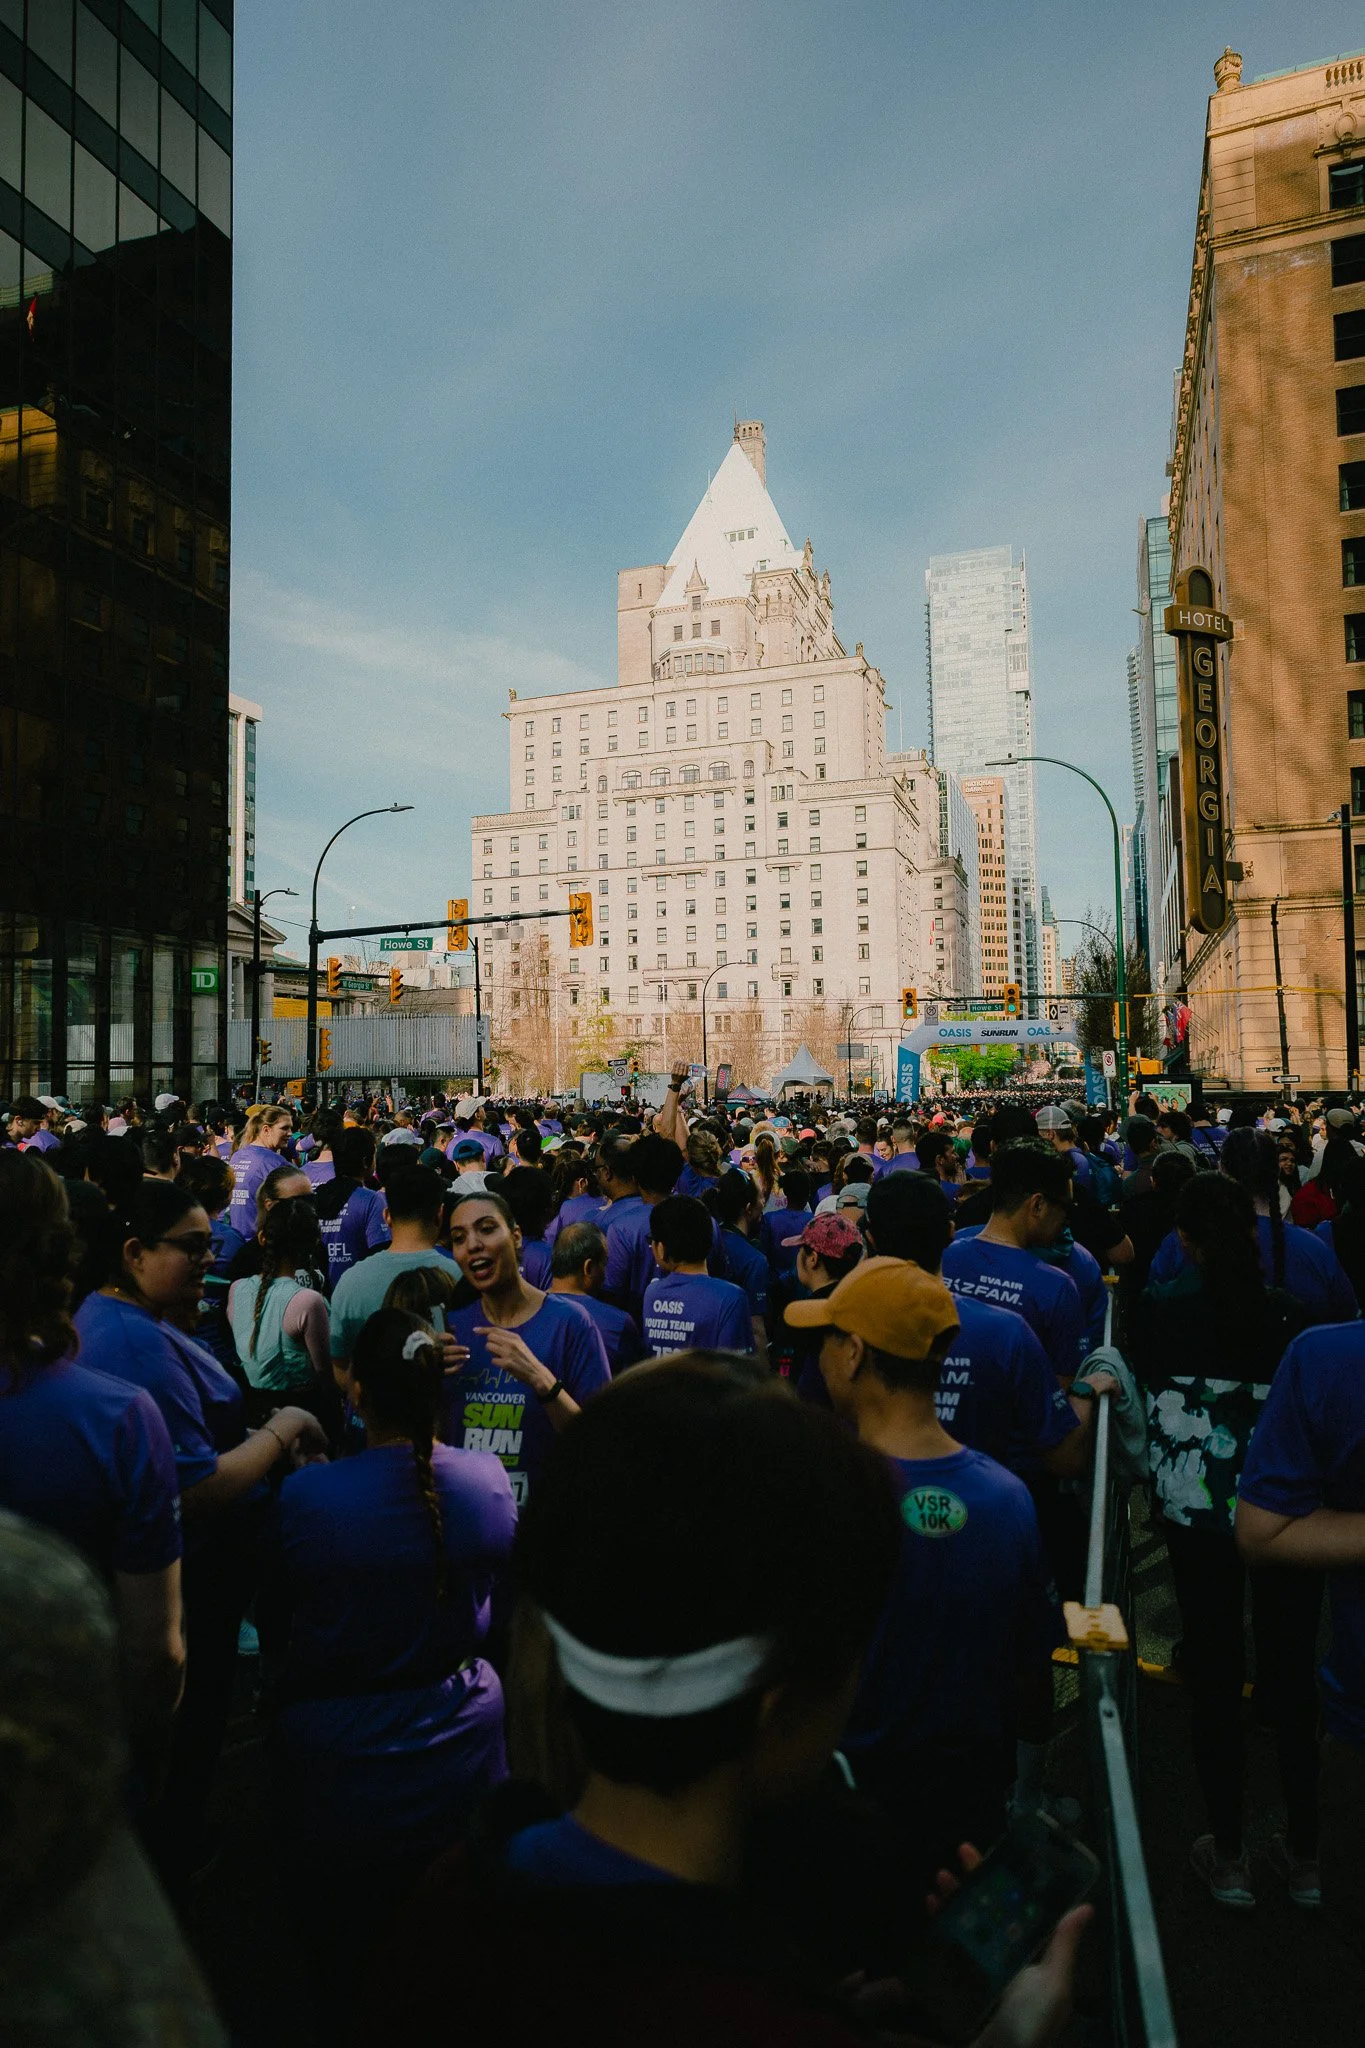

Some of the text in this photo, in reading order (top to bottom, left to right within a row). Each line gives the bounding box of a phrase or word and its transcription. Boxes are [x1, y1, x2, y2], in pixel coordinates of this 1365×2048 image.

[1179, 610, 1228, 633] HOTEL
[1193, 646, 1223, 894] GEORGIA
[384, 939, 429, 949] Howe St
[192, 972, 215, 988] TD
[972, 1004, 992, 1012] Howe
[939, 1028, 972, 1038] OASIS
[1027, 1026, 1061, 1036] OAS
[328, 1243, 352, 1257] BFL
[1001, 1280, 1023, 1291] AIR
[653, 1299, 685, 1315] OASIS
[669, 1319, 695, 1332] TEAM
[648, 1328, 687, 1342] DIVISION
[465, 1392, 526, 1404] VANCOUVER
[463, 1402, 525, 1429] SUN
[463, 1428, 523, 1454] RUN
[914, 1495, 951, 1512] VSR
[920, 1513, 950, 1530] 10K
